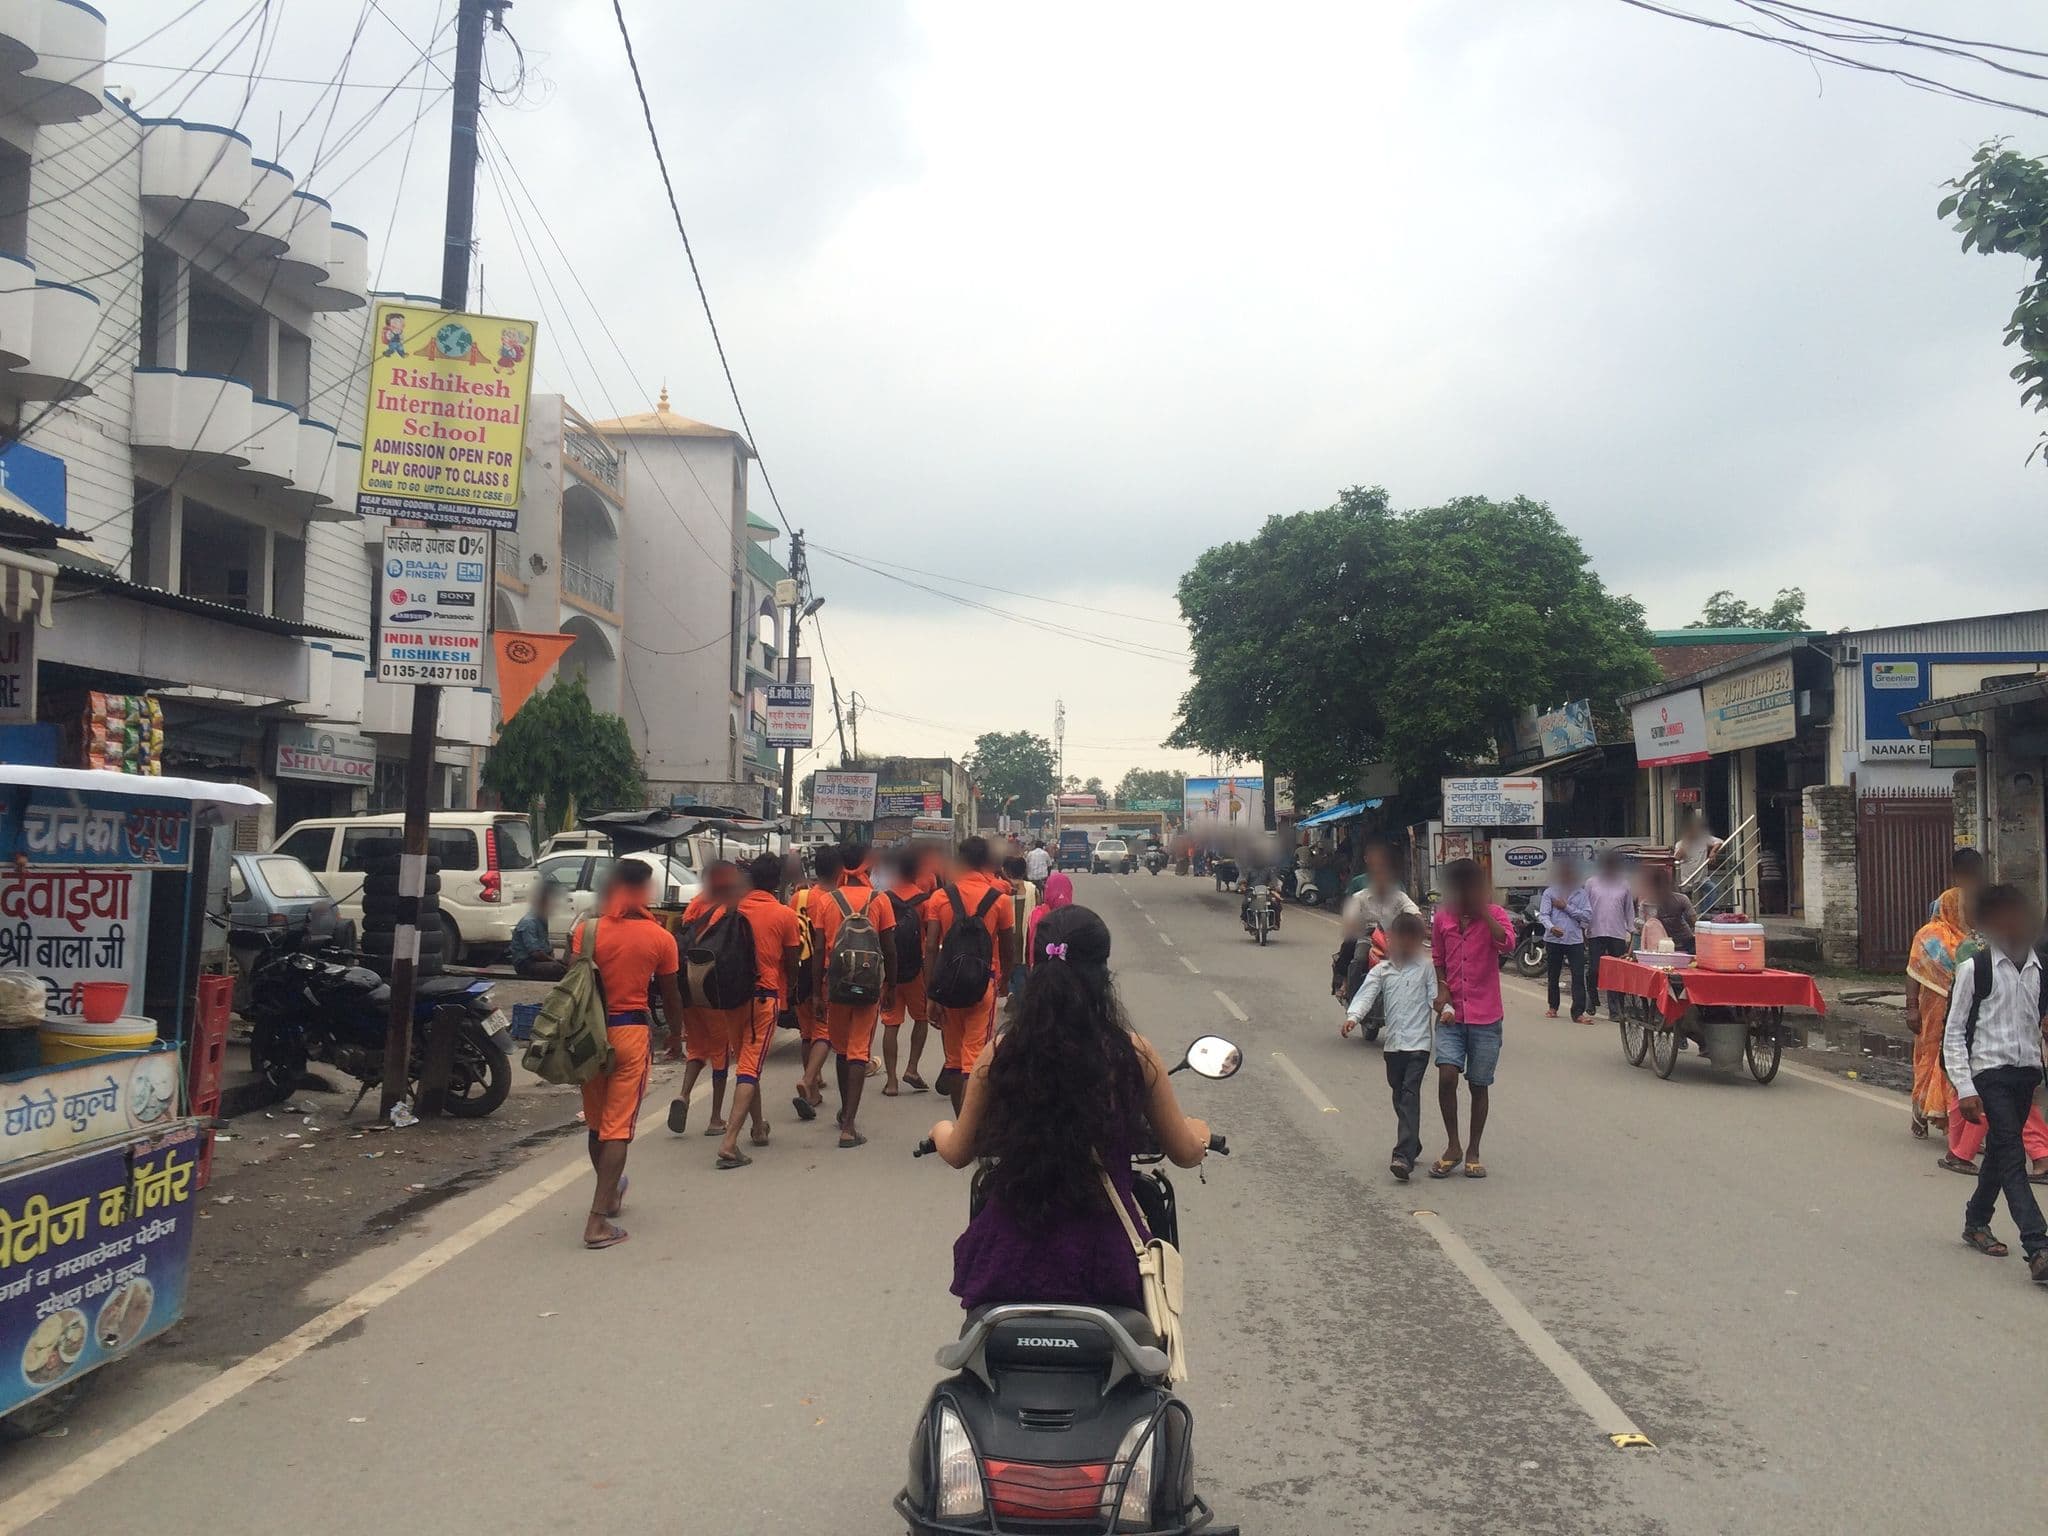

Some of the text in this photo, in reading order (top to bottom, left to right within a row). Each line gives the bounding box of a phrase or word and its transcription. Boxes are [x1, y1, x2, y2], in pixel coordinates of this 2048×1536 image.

[391, 367, 511, 398] Rishikesh
[376, 389, 520, 425] International
[403, 418, 486, 443] School
[374, 438, 512, 467] ADMISSION OPEN FOR
[372, 459, 509, 487] PLAY GROUP TO CLASS 8
[368, 478, 393, 489] GOING
[397, 481, 408, 490] TO
[409, 482, 420, 492] GO
[424, 484, 444, 494] UPTO
[446, 486, 470, 498] CLASS
[472, 490, 481, 499] 12
[483, 490, 503, 501] CBSE
[360, 495, 381, 504] NEAR
[477, 507, 516, 519] RISHIKESH
[459, 536, 484, 556] 0%
[405, 560, 448, 570] BAJAJ
[458, 563, 481, 576] EMI
[405, 570, 449, 580] FINSERV
[411, 594, 426, 602] LG
[440, 592, 473, 600] SONY
[434, 612, 474, 621] Panasonic
[384, 633, 479, 647] INDIA VISION
[391, 648, 470, 662] RISHIKESH
[382, 664, 477, 681] 0135-2437108
[1875, 674, 1917, 682] Greenlam
[1872, 745, 1915, 755] NANAK
[280, 746, 373, 776] SHIVLOK
[37, 937, 92, 969] बाला
[95, 923, 126, 969] जी
[5, 1088, 58, 1136] छोले
[36, 1268, 52, 1287] व
[1017, 1337, 1079, 1348] HONDA
